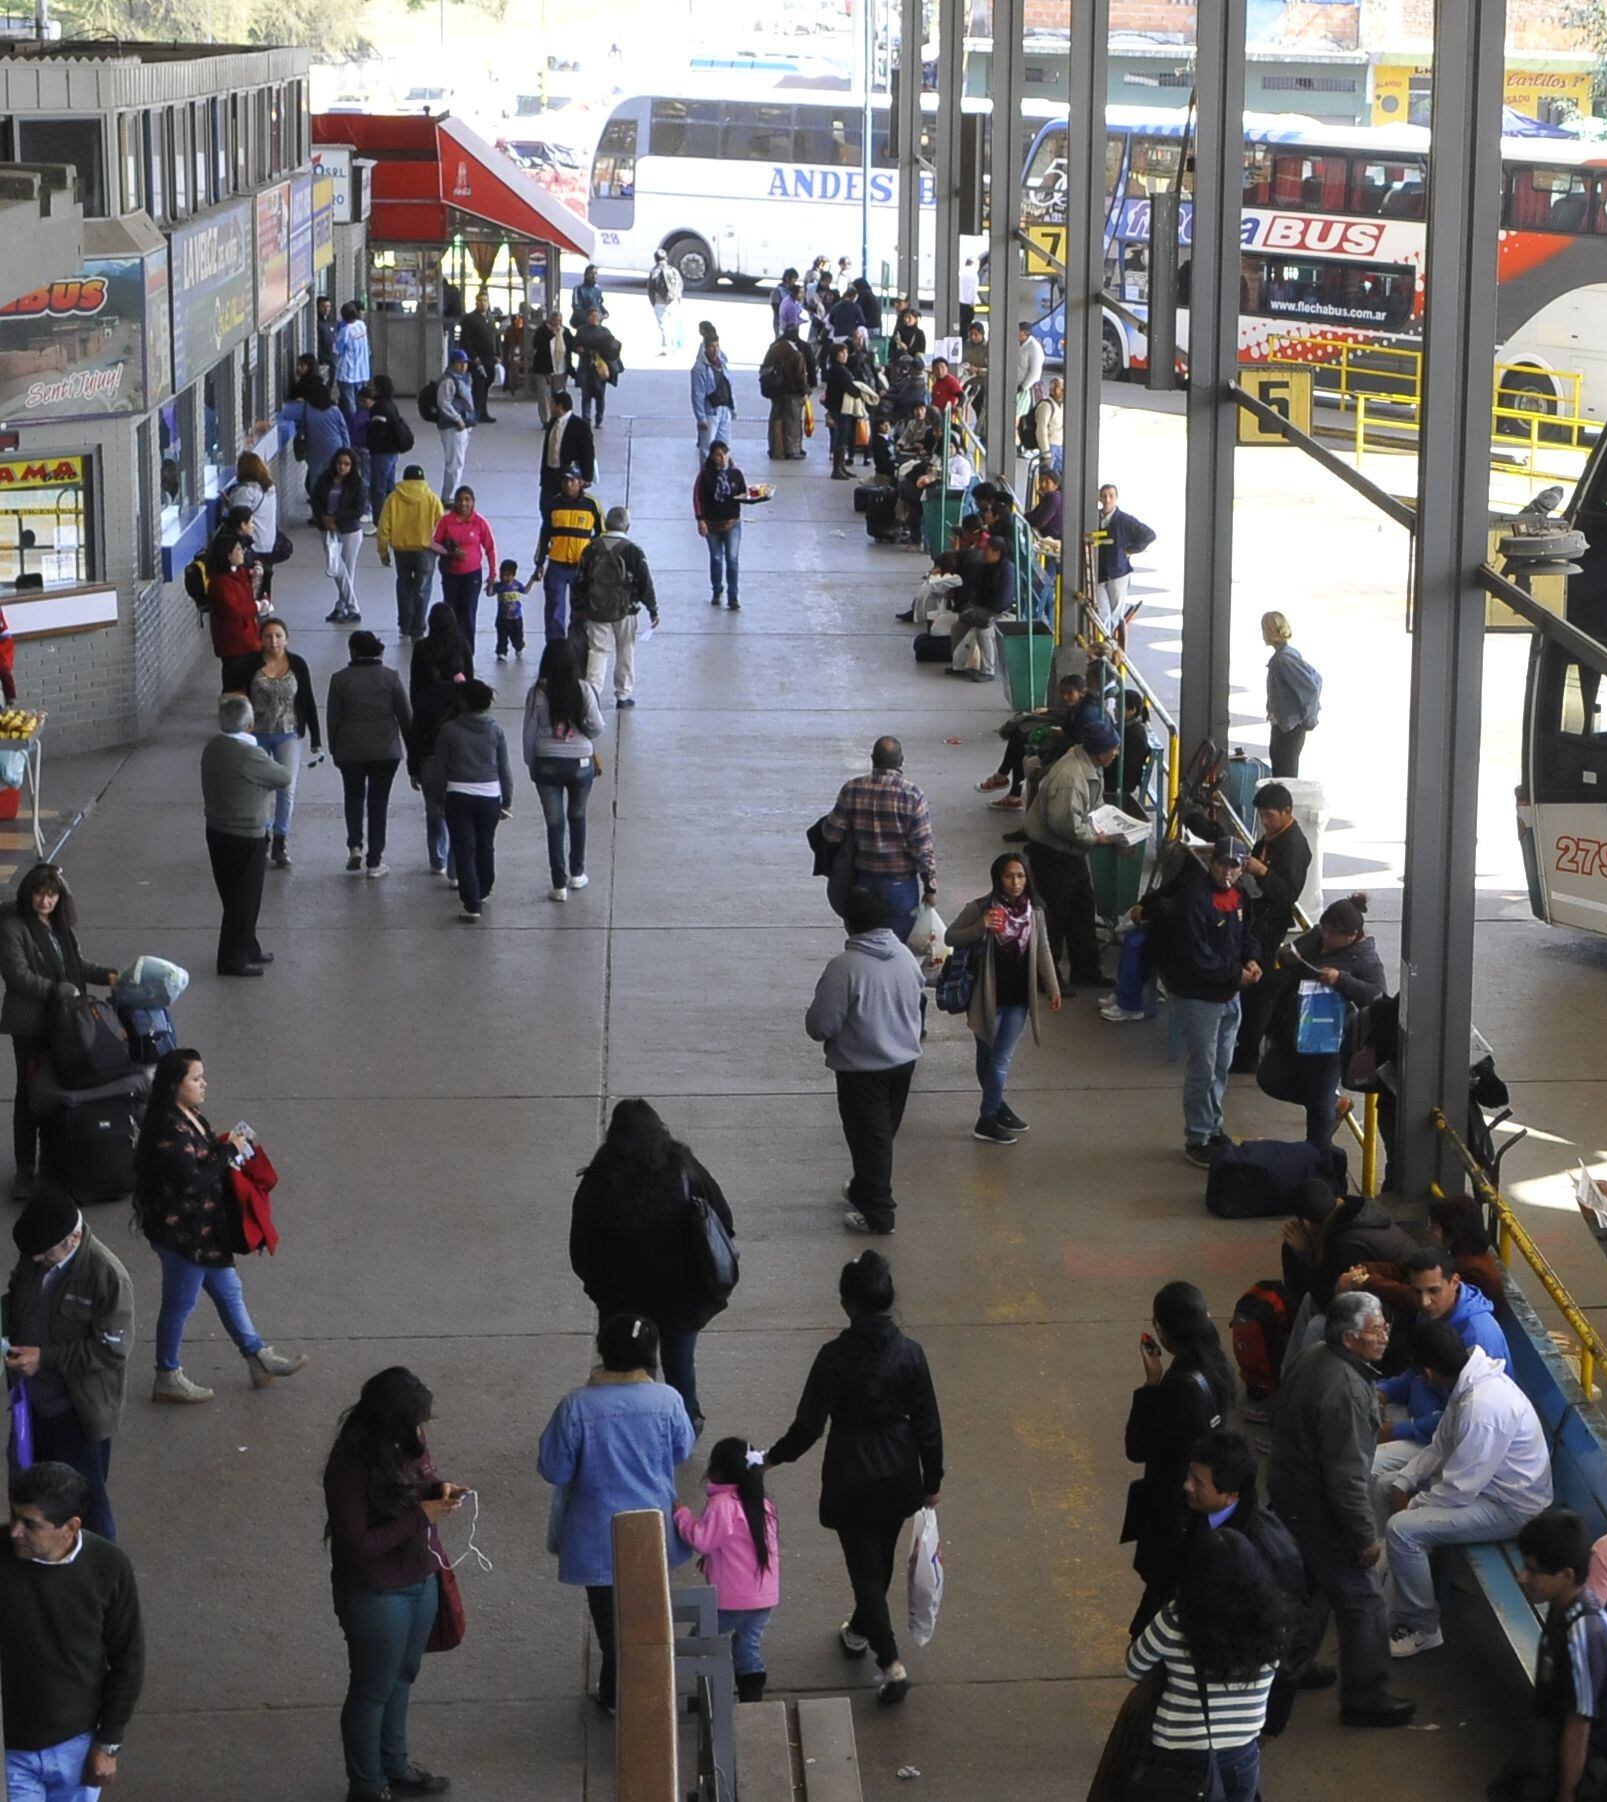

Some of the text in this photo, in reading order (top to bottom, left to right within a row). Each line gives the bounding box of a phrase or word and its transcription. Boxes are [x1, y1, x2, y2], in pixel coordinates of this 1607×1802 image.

[767, 168, 894, 202] ANDES
[601, 232, 620, 246] 28
[1041, 232, 1061, 267] 7
[1265, 218, 1379, 254] BUS
[1270, 300, 1387, 321] www.flechabus.com.ar
[1258, 380, 1290, 439] 5
